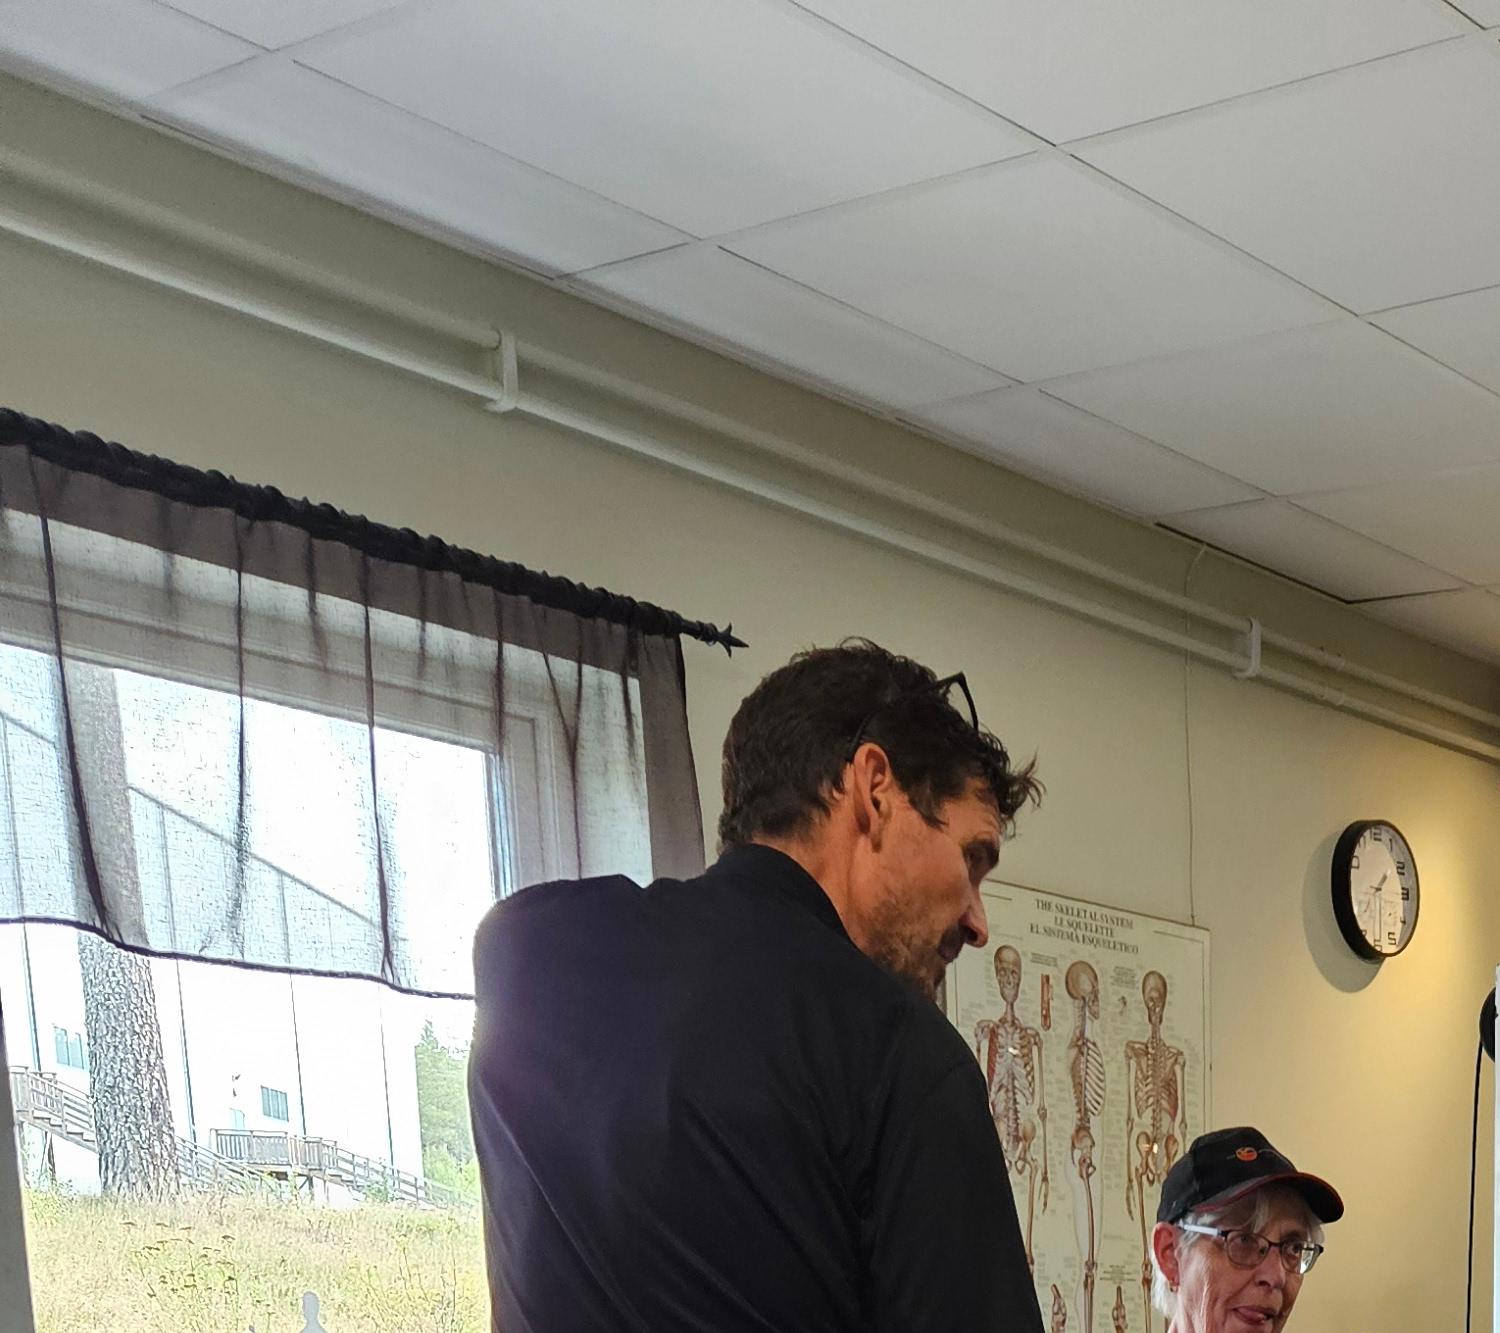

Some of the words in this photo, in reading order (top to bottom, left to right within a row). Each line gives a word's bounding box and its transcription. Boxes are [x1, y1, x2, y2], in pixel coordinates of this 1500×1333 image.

[1035, 898, 1053, 912] THE
[1055, 902, 1099, 922] SKELETAL
[1101, 912, 1134, 930] SYSTEM
[1030, 922, 1041, 935] EL
[1043, 925, 1081, 944] SISTEMA
